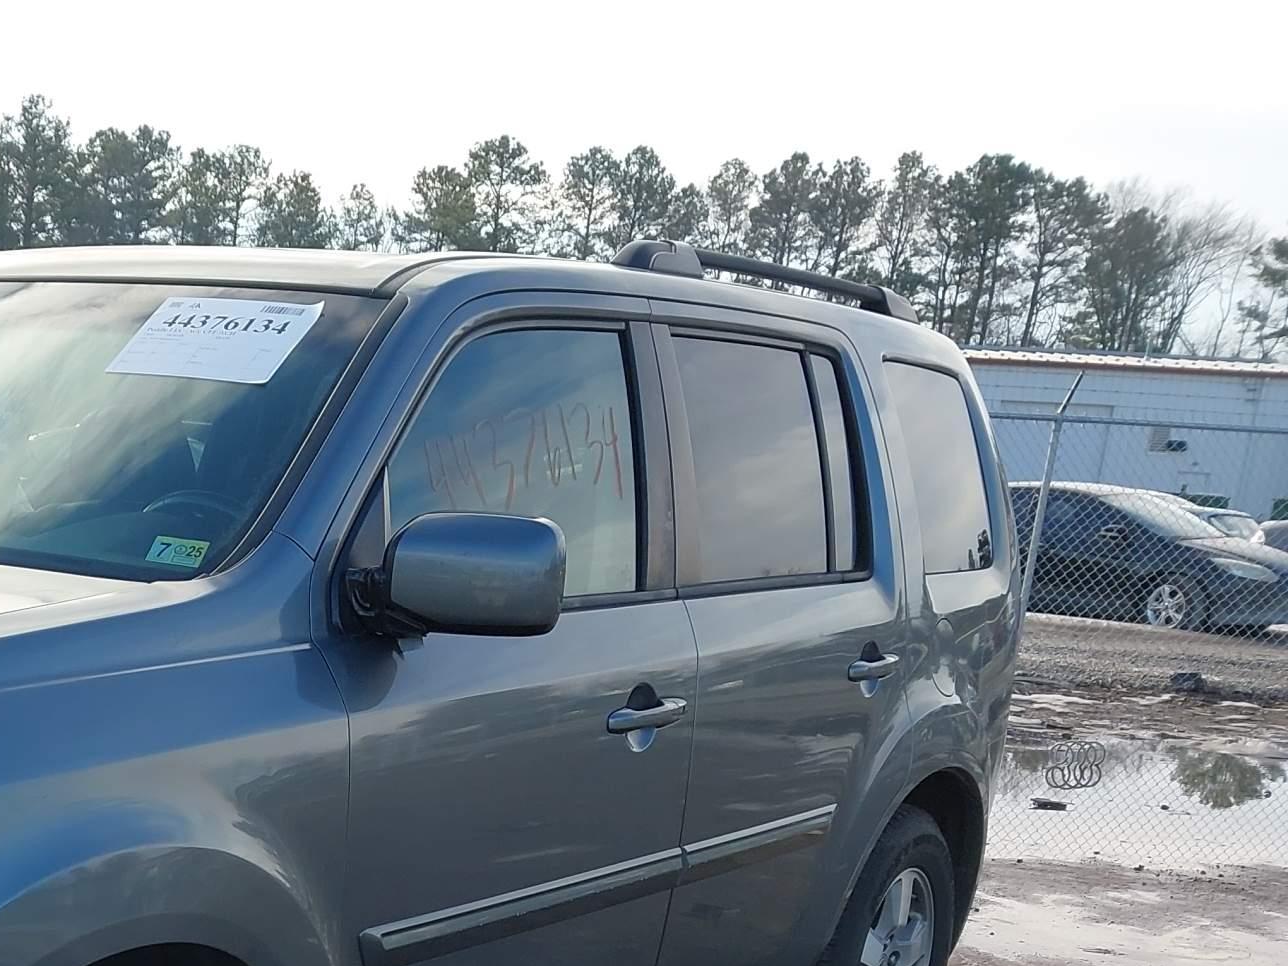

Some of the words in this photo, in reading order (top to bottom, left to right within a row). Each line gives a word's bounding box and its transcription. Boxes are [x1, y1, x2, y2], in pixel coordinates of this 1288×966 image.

[162, 313, 292, 335] 44376134
[157, 542, 172, 557] 7
[186, 545, 205, 558] 25
